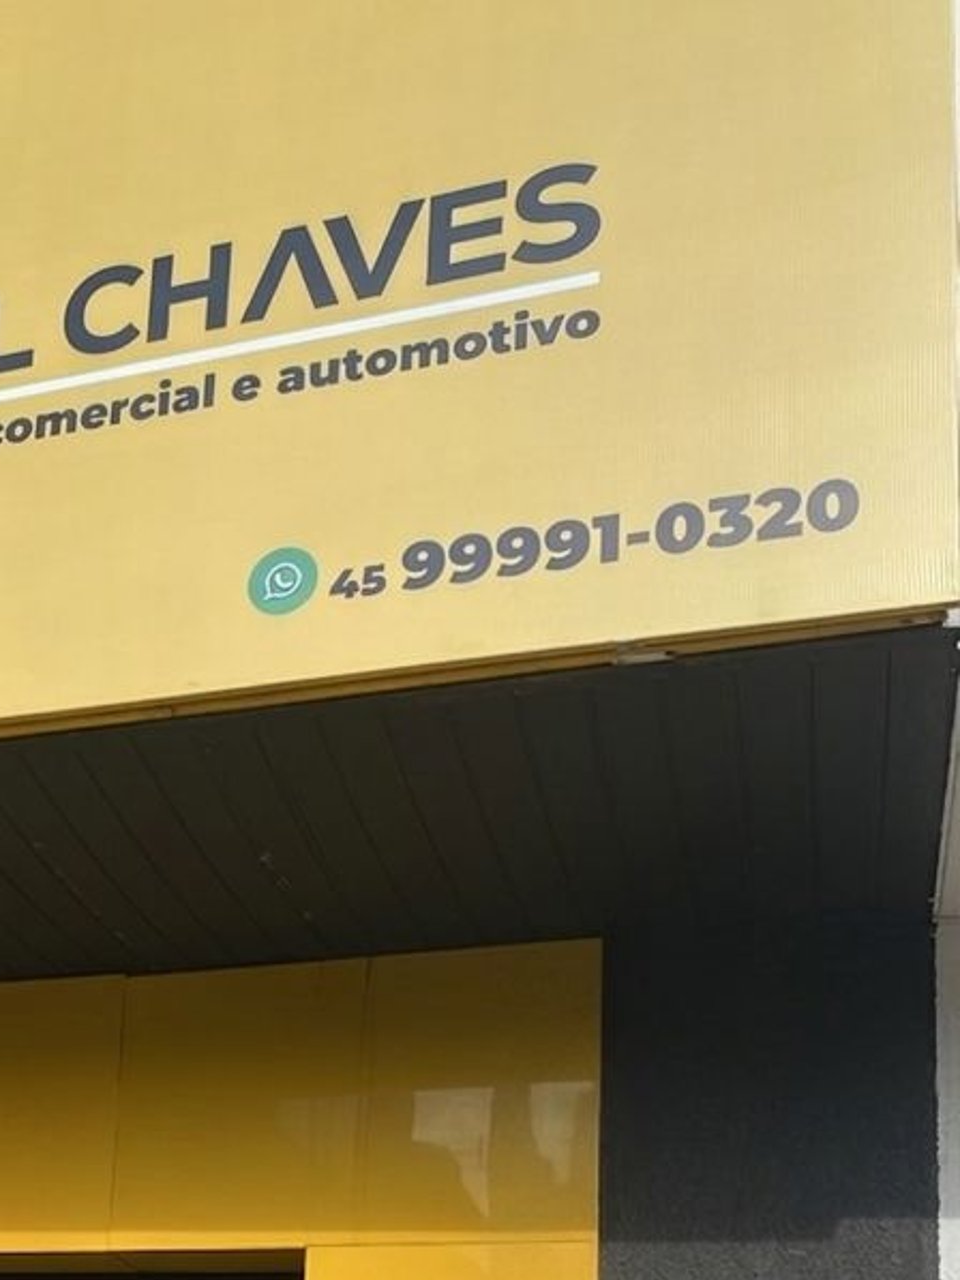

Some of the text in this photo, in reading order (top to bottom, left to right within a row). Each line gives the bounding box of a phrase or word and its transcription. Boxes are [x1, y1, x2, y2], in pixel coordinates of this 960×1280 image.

[63, 163, 601, 354] CHAVES
[232, 374, 260, 401] e
[276, 309, 601, 394] automotivo
[329, 478, 860, 599] 45 99991-0320
